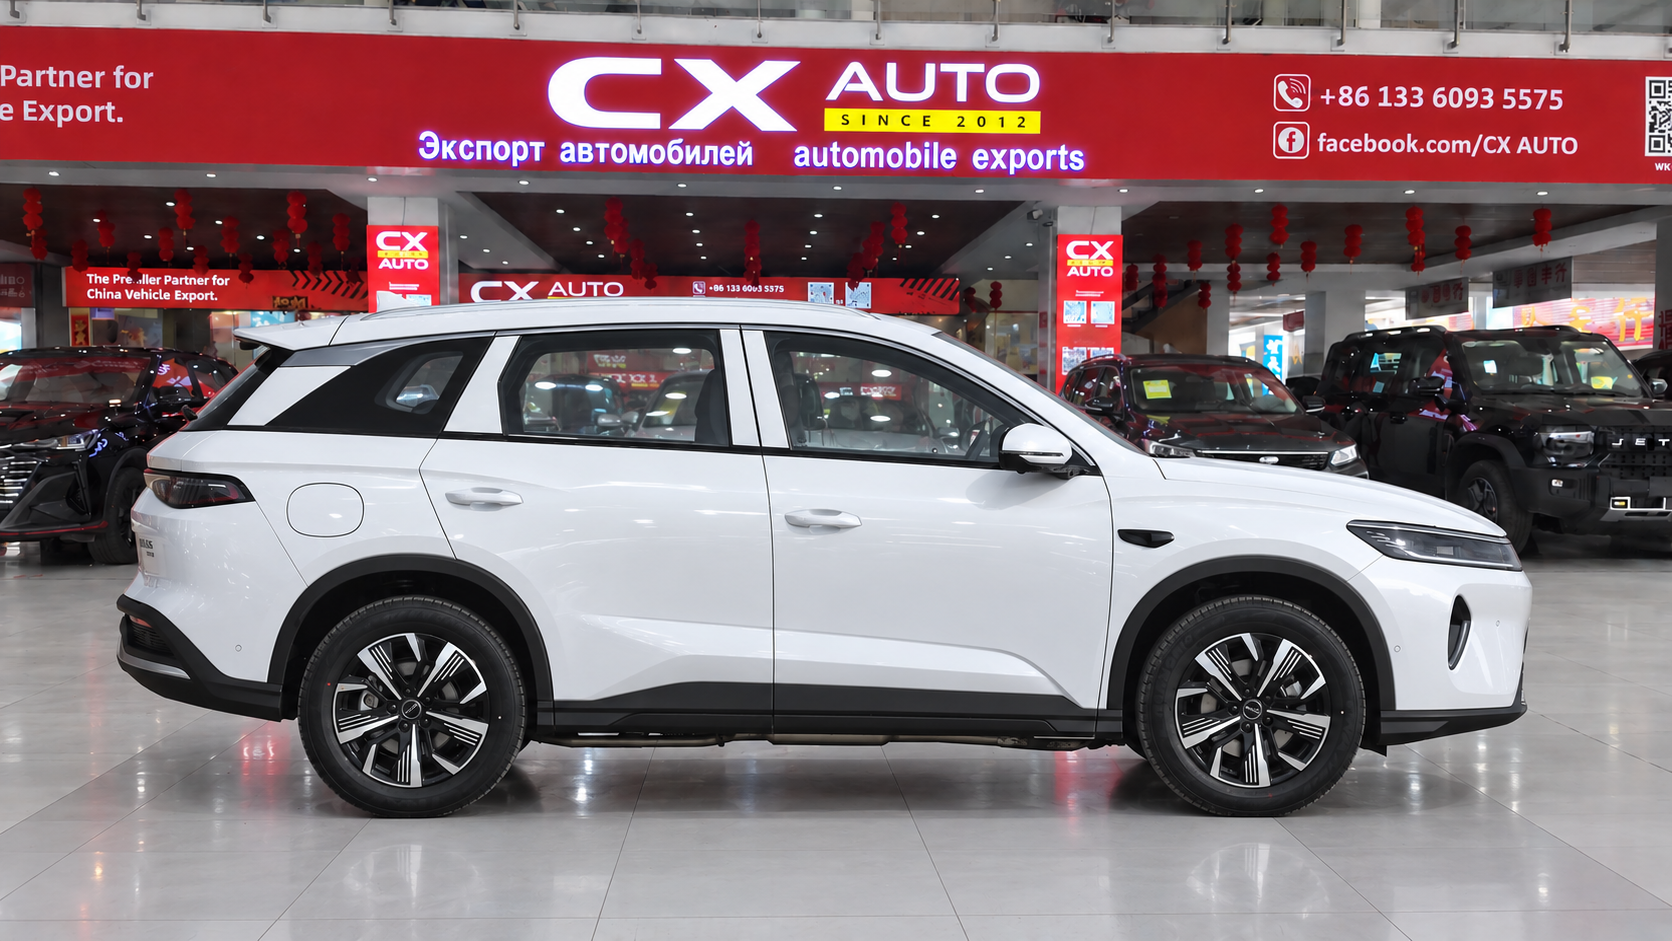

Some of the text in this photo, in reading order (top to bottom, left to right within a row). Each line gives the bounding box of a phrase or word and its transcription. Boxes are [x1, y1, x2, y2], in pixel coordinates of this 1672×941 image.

[0, 65, 154, 89] Partner for
[547, 56, 1041, 132] CX AUTO
[1320, 85, 1563, 111] +86 133 6093 5575
[23, 100, 123, 128] Export.
[841, 113, 1026, 128] SINCE 2012
[418, 130, 753, 167] Экспорт автомобилей
[1317, 132, 1578, 157] facebook.com/CX AUTO
[794, 141, 1085, 175] automobile exports
[376, 231, 428, 251] CX
[1066, 240, 1114, 260] CX
[378, 258, 429, 270] AUTO
[1066, 266, 1114, 277] AUTO
[86, 274, 110, 284] The
[164, 275, 209, 285] Partner
[212, 275, 230, 286] for
[86, 288, 218, 303] China Vehicle Export.
[470, 281, 625, 303] CX AUTO
